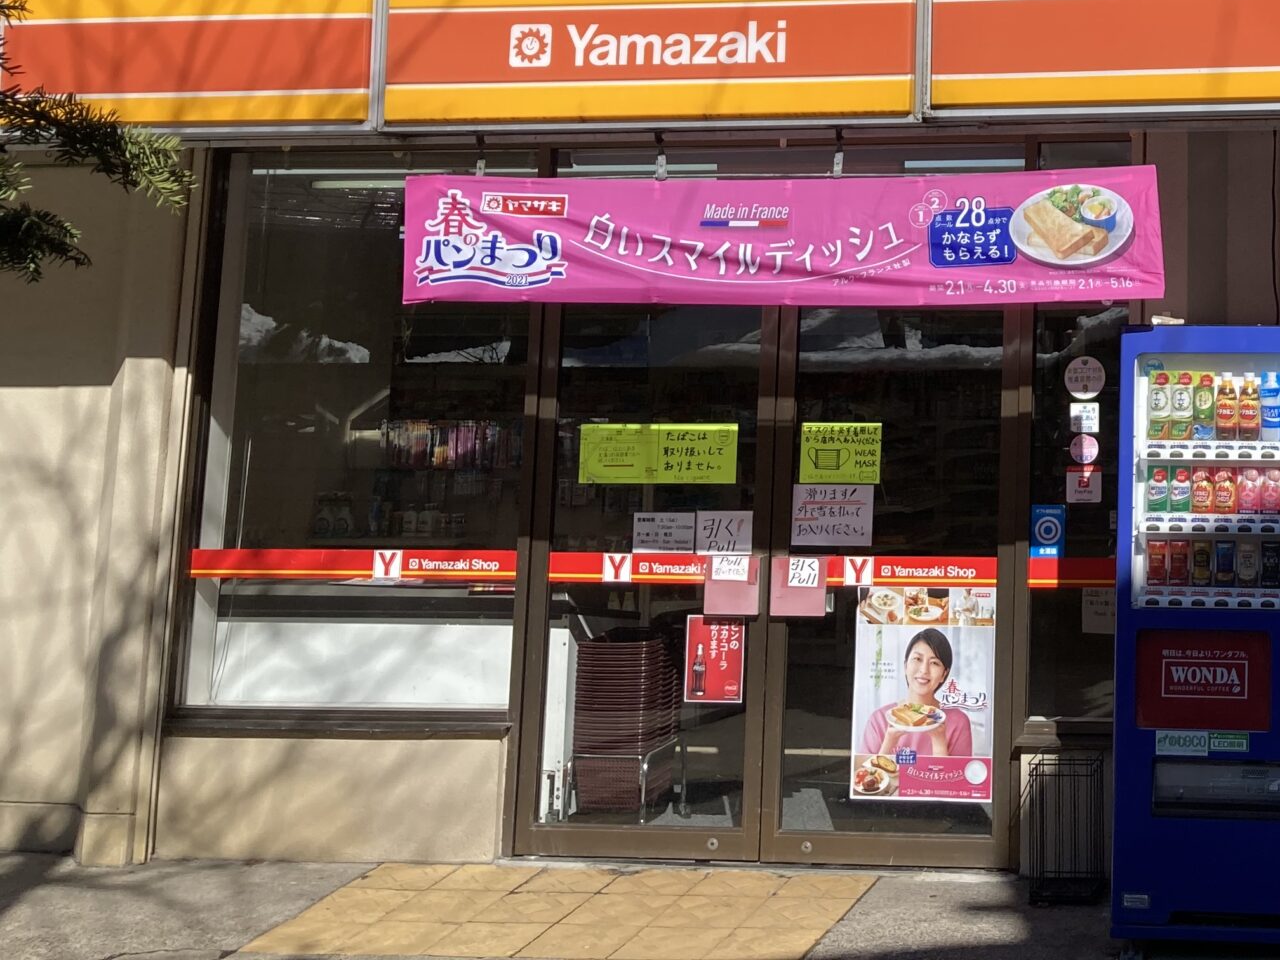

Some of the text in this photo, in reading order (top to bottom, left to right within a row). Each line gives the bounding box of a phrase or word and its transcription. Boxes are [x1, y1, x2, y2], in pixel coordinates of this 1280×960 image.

[566, 19, 788, 67] Yamazaki
[506, 199, 562, 213] ヤマザキ
[703, 203, 790, 219] Made in France
[955, 197, 986, 227] 28
[942, 228, 1001, 245] かならず
[419, 233, 559, 269] パンまつり
[584, 212, 905, 277] 白いスマイルディッシュ
[505, 275, 529, 286] 2021
[666, 431, 708, 442] たばこは
[662, 445, 724, 458] 取り扱いして
[854, 448, 877, 458] WEAR
[663, 460, 722, 473] おりません。
[854, 459, 877, 469] MASK
[796, 504, 862, 518] 外で雪を払って
[706, 539, 737, 553] Pull
[379, 552, 500, 577] Y Yamazaki Shop
[607, 555, 627, 580] Y
[650, 562, 701, 574] Yamazaki
[719, 556, 743, 567] Pull
[790, 558, 816, 572] 引く
[848, 558, 976, 584] Y Yamazaki Shop
[789, 571, 817, 586] Pull
[1170, 665, 1241, 685] WONDA
